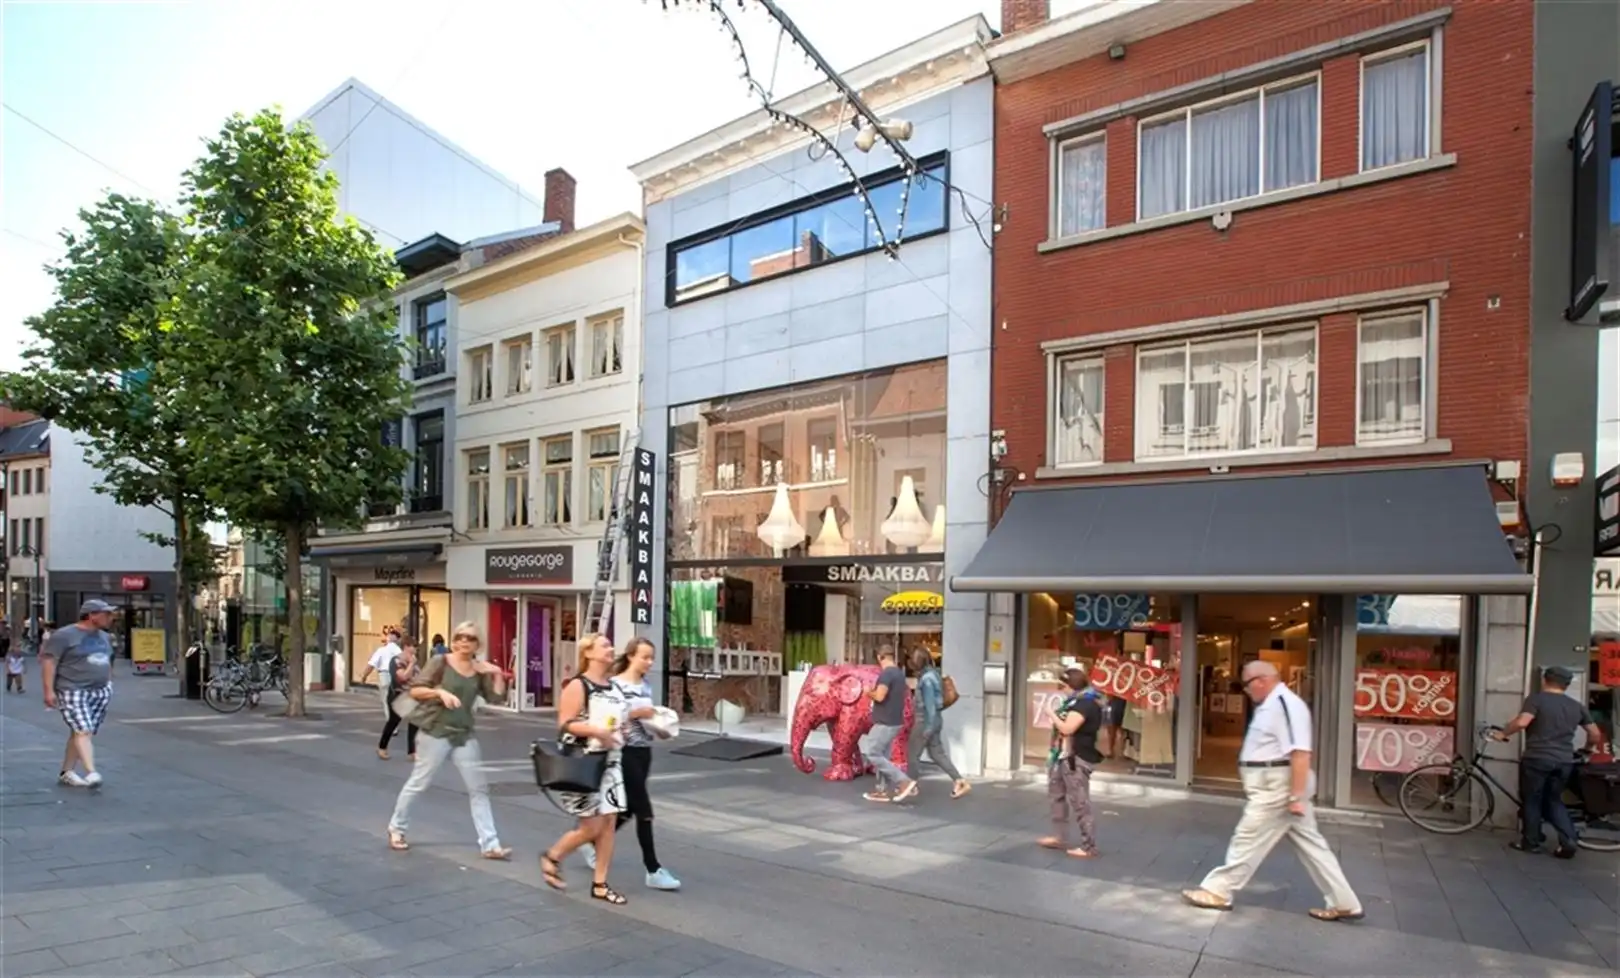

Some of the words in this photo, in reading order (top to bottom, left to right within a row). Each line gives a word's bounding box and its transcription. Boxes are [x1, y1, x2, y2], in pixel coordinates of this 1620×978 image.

[827, 566, 944, 582] SMAAKBA
[1075, 593, 1147, 627] 30%
[1092, 654, 1165, 706] 50%
[1354, 673, 1454, 716] 50%
[1411, 675, 1451, 714] KORTING
[1032, 692, 1064, 728] 70
[1357, 727, 1451, 768] 70%
